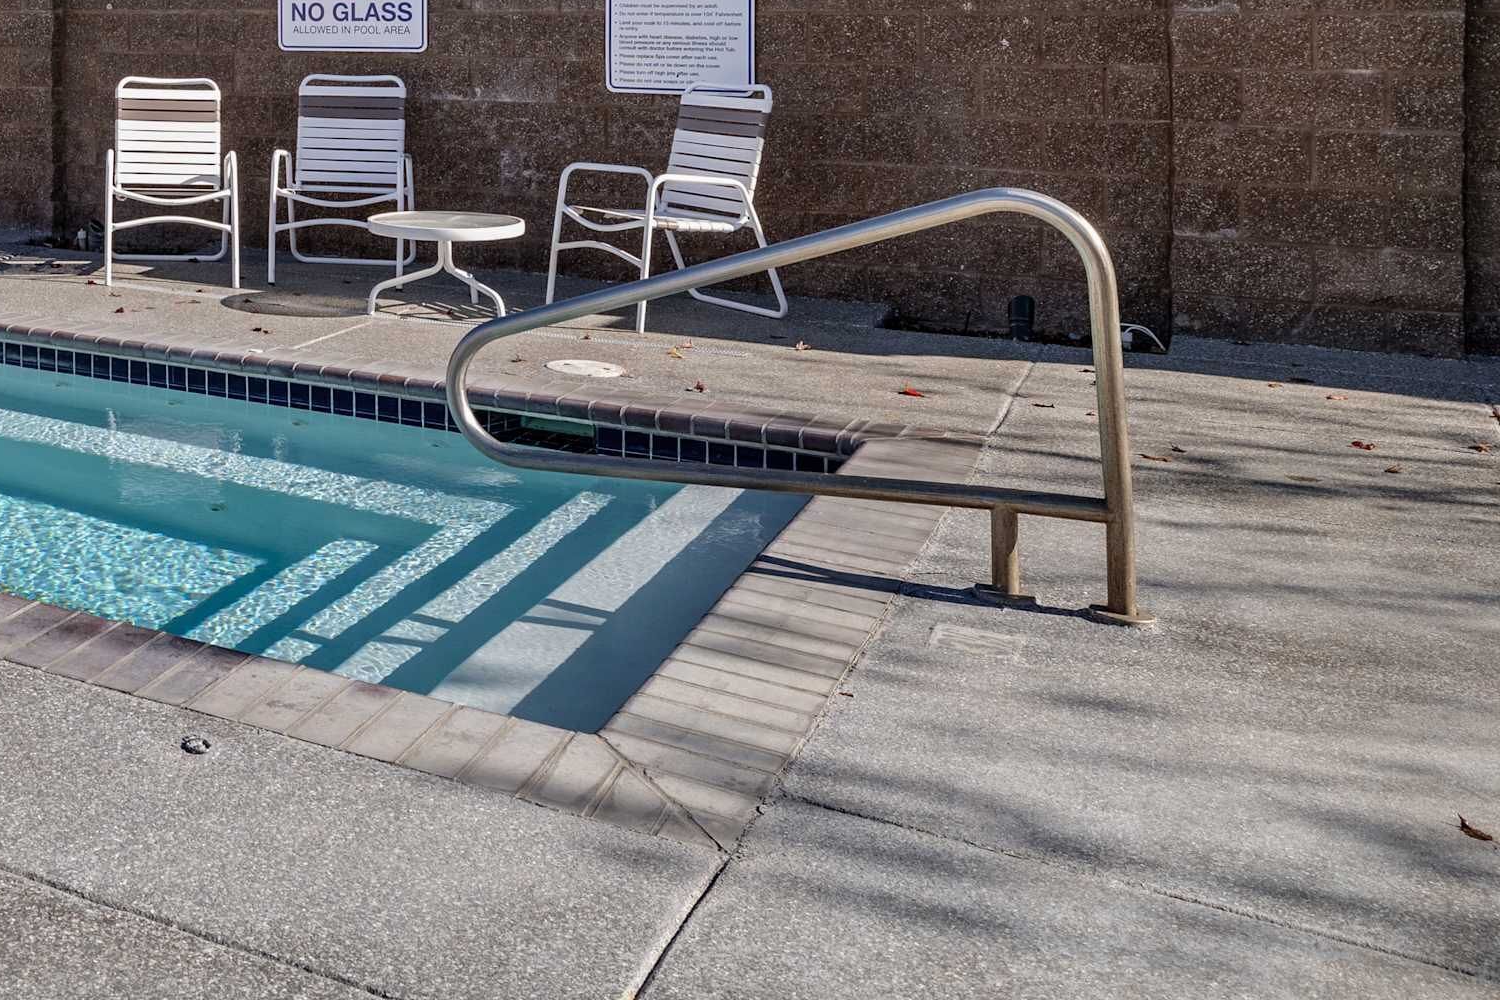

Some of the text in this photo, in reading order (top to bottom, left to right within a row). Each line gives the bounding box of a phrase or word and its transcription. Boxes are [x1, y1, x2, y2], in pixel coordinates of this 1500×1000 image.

[292, 2, 413, 23] NO GLASS
[292, 25, 411, 35] ALLOWED IN POOL AREA
